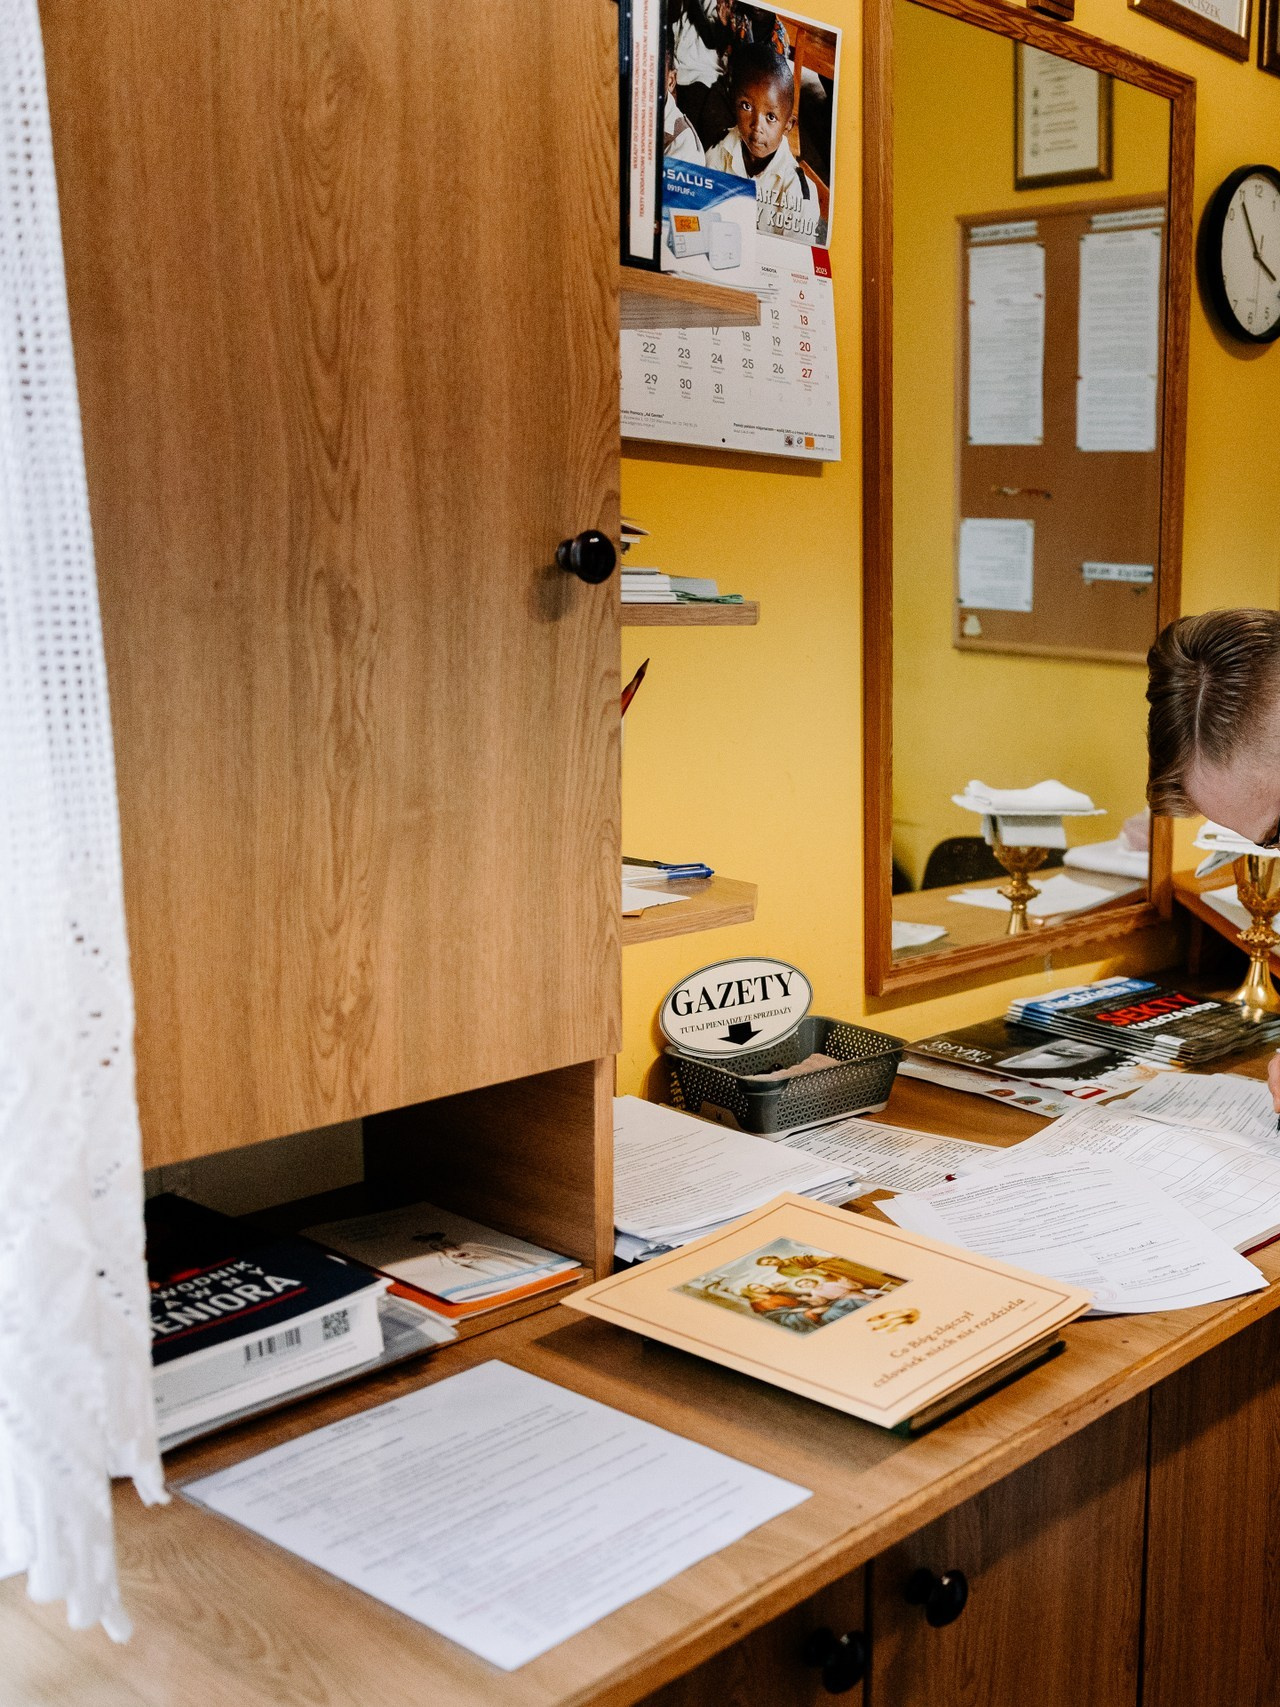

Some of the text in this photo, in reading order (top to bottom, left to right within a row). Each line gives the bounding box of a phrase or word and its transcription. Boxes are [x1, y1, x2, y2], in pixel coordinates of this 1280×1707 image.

[666, 168, 714, 190] SALUS
[1254, 184, 1263, 198] 12
[761, 266, 778, 274] SOBOTA
[798, 290, 805, 300] 6
[770, 308, 809, 326] 12 13
[1247, 312, 1253, 325] 6
[1265, 306, 1270, 320] 5
[742, 330, 751, 342] 18
[772, 336, 780, 347] 19
[799, 341, 811, 352] 20
[642, 342, 812, 379] 22 23 24 25 26 27
[644, 373, 658, 385] 29
[679, 378, 692, 390] 30
[714, 383, 723, 394] 31
[671, 971, 794, 1017] GAZETY
[680, 1023, 706, 1034] TUTAJ
[706, 1016, 743, 1030] PIENIĄDZE
[753, 1006, 792, 1020] SPRZEDAŻY
[1096, 992, 1199, 1027] SEKTY
[1127, 1008, 1188, 1030] KALECZĄ
[150, 1275, 302, 1339] ENIORA
[873, 1354, 925, 1389] człowiek
[925, 1338, 957, 1357] niech
[956, 1328, 976, 1340] nie
[974, 1297, 1026, 1330] rozdziela
[890, 1310, 974, 1359] Co Bóg złączył
